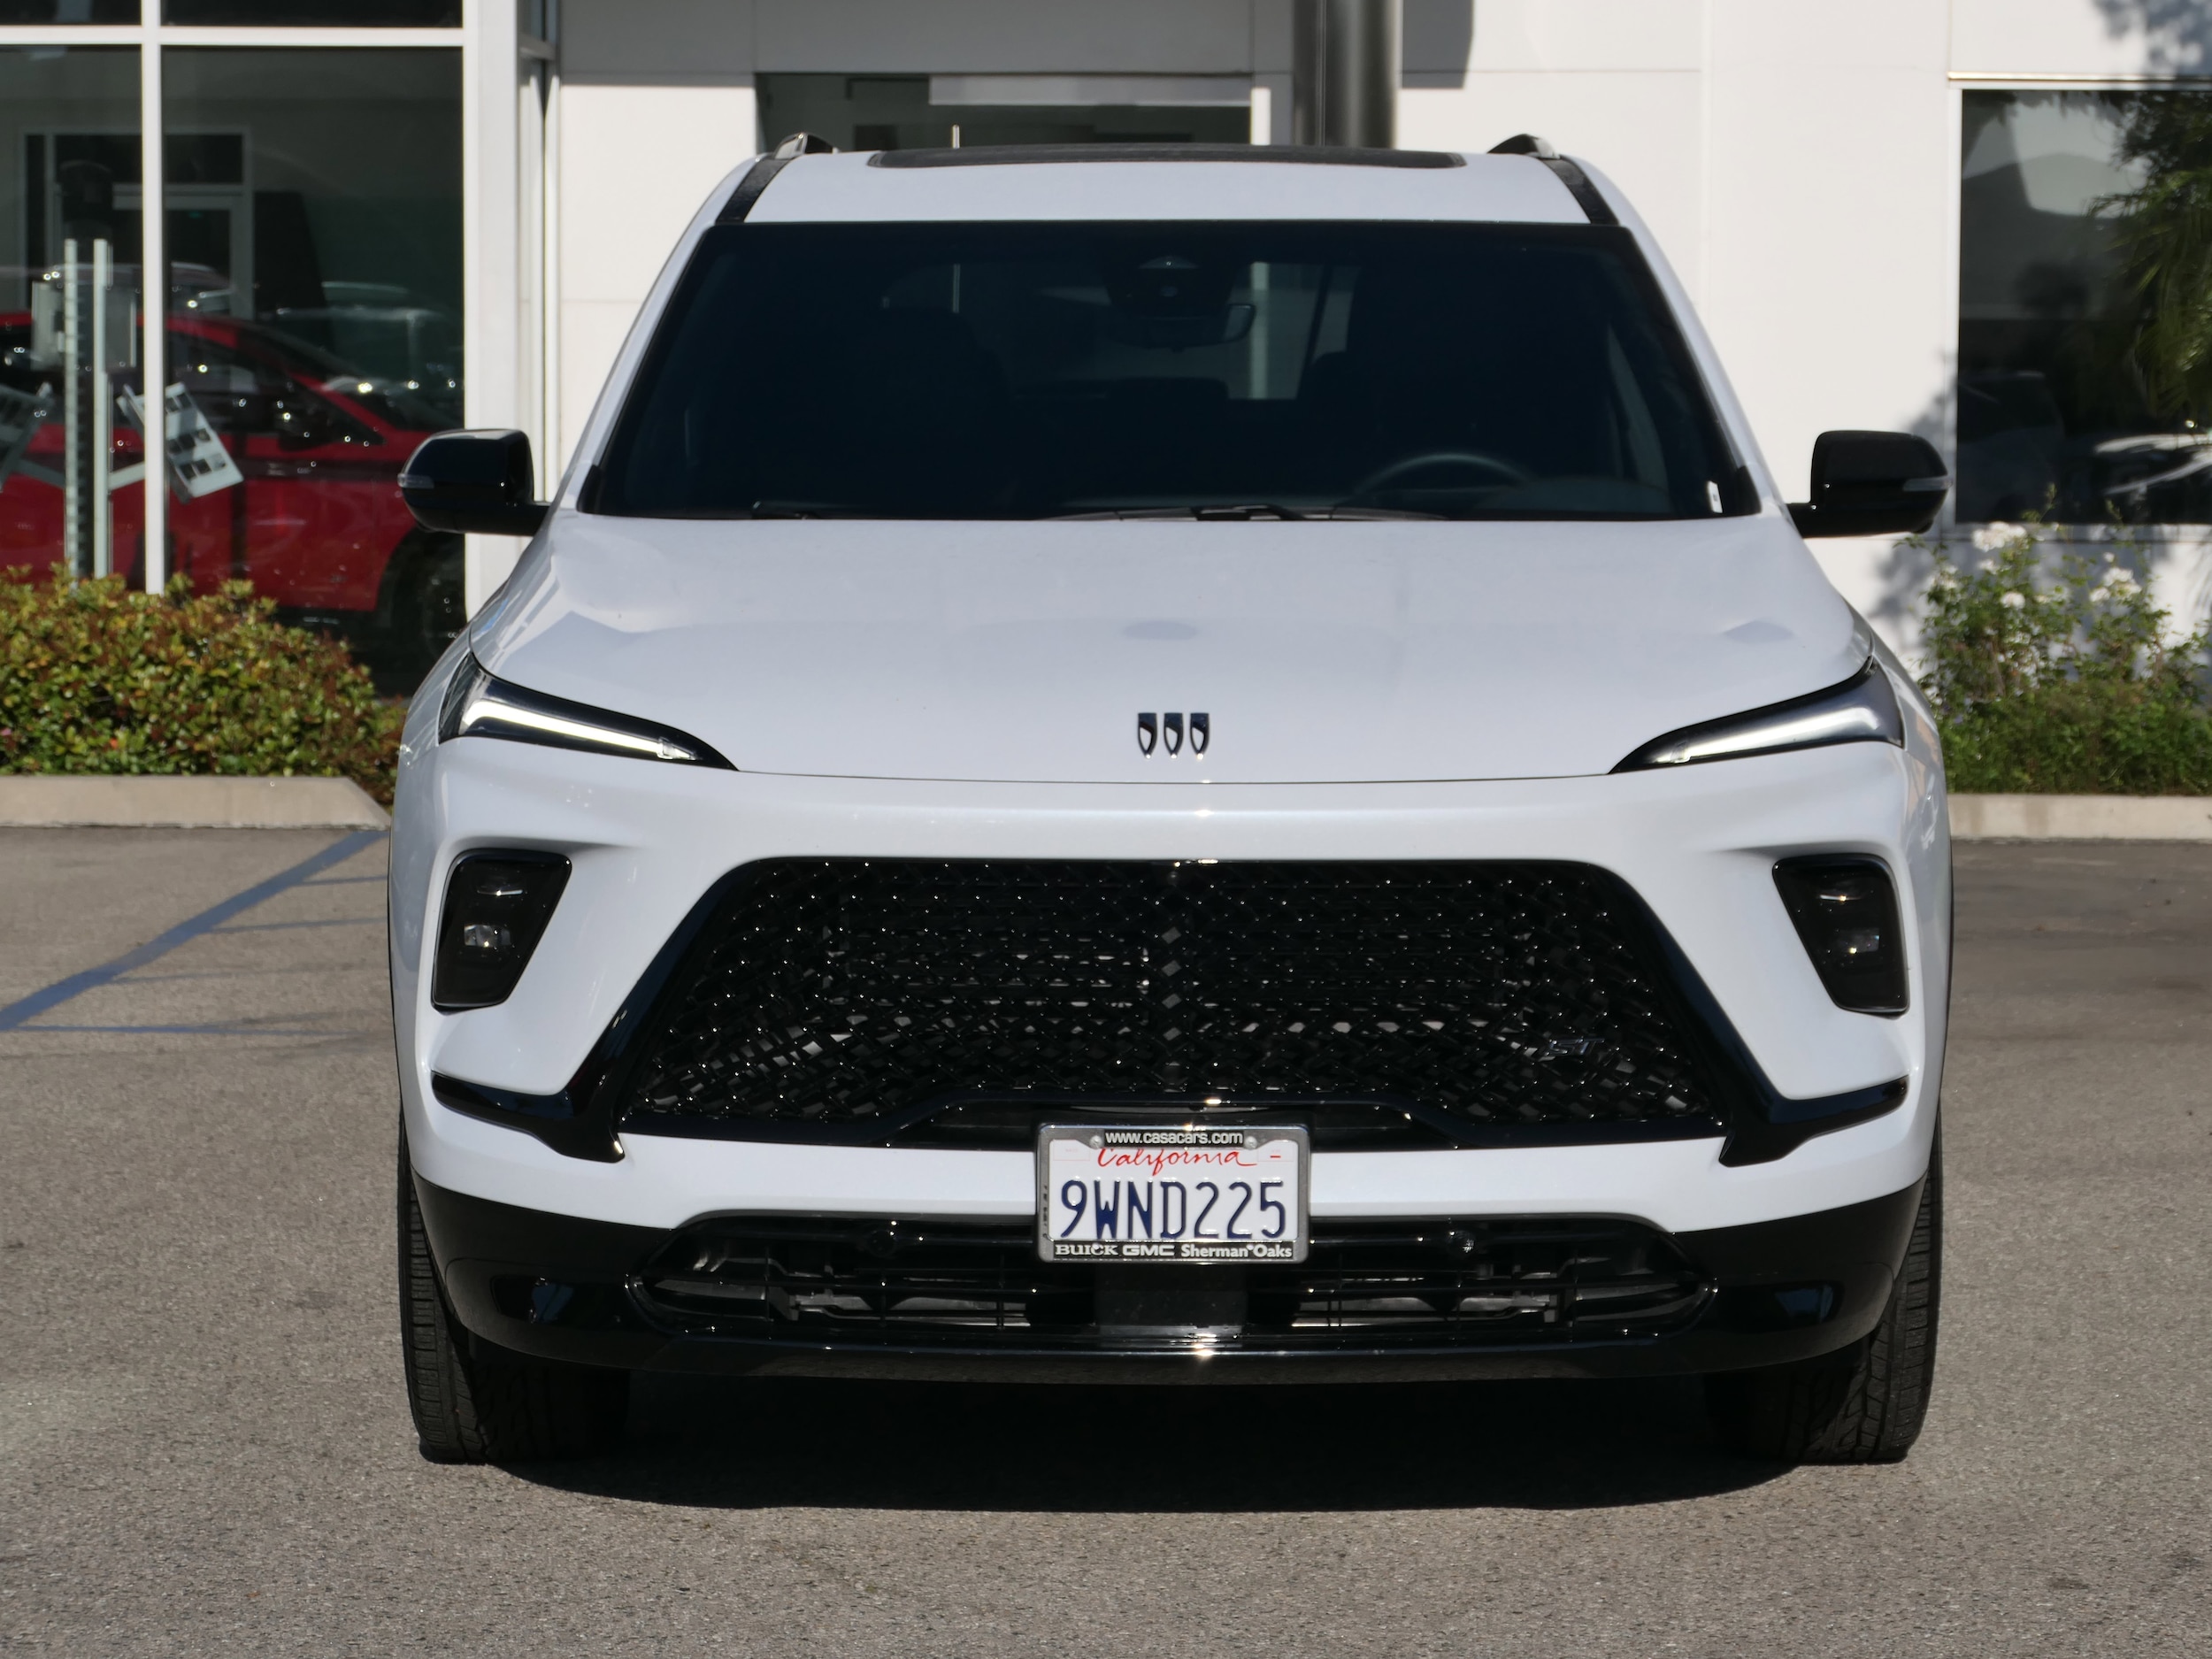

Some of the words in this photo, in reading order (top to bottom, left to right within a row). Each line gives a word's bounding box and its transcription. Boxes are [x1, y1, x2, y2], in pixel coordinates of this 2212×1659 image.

[1105, 1132, 1243, 1144] www.casacars.com
[1097, 1148, 1257, 1177] California
[1060, 1179, 1286, 1240] 9WND225
[1055, 1243, 1118, 1256] BUICK
[1122, 1244, 1175, 1256] GMC
[1181, 1243, 1248, 1257] Sherman
[1253, 1244, 1292, 1257] Oaks
